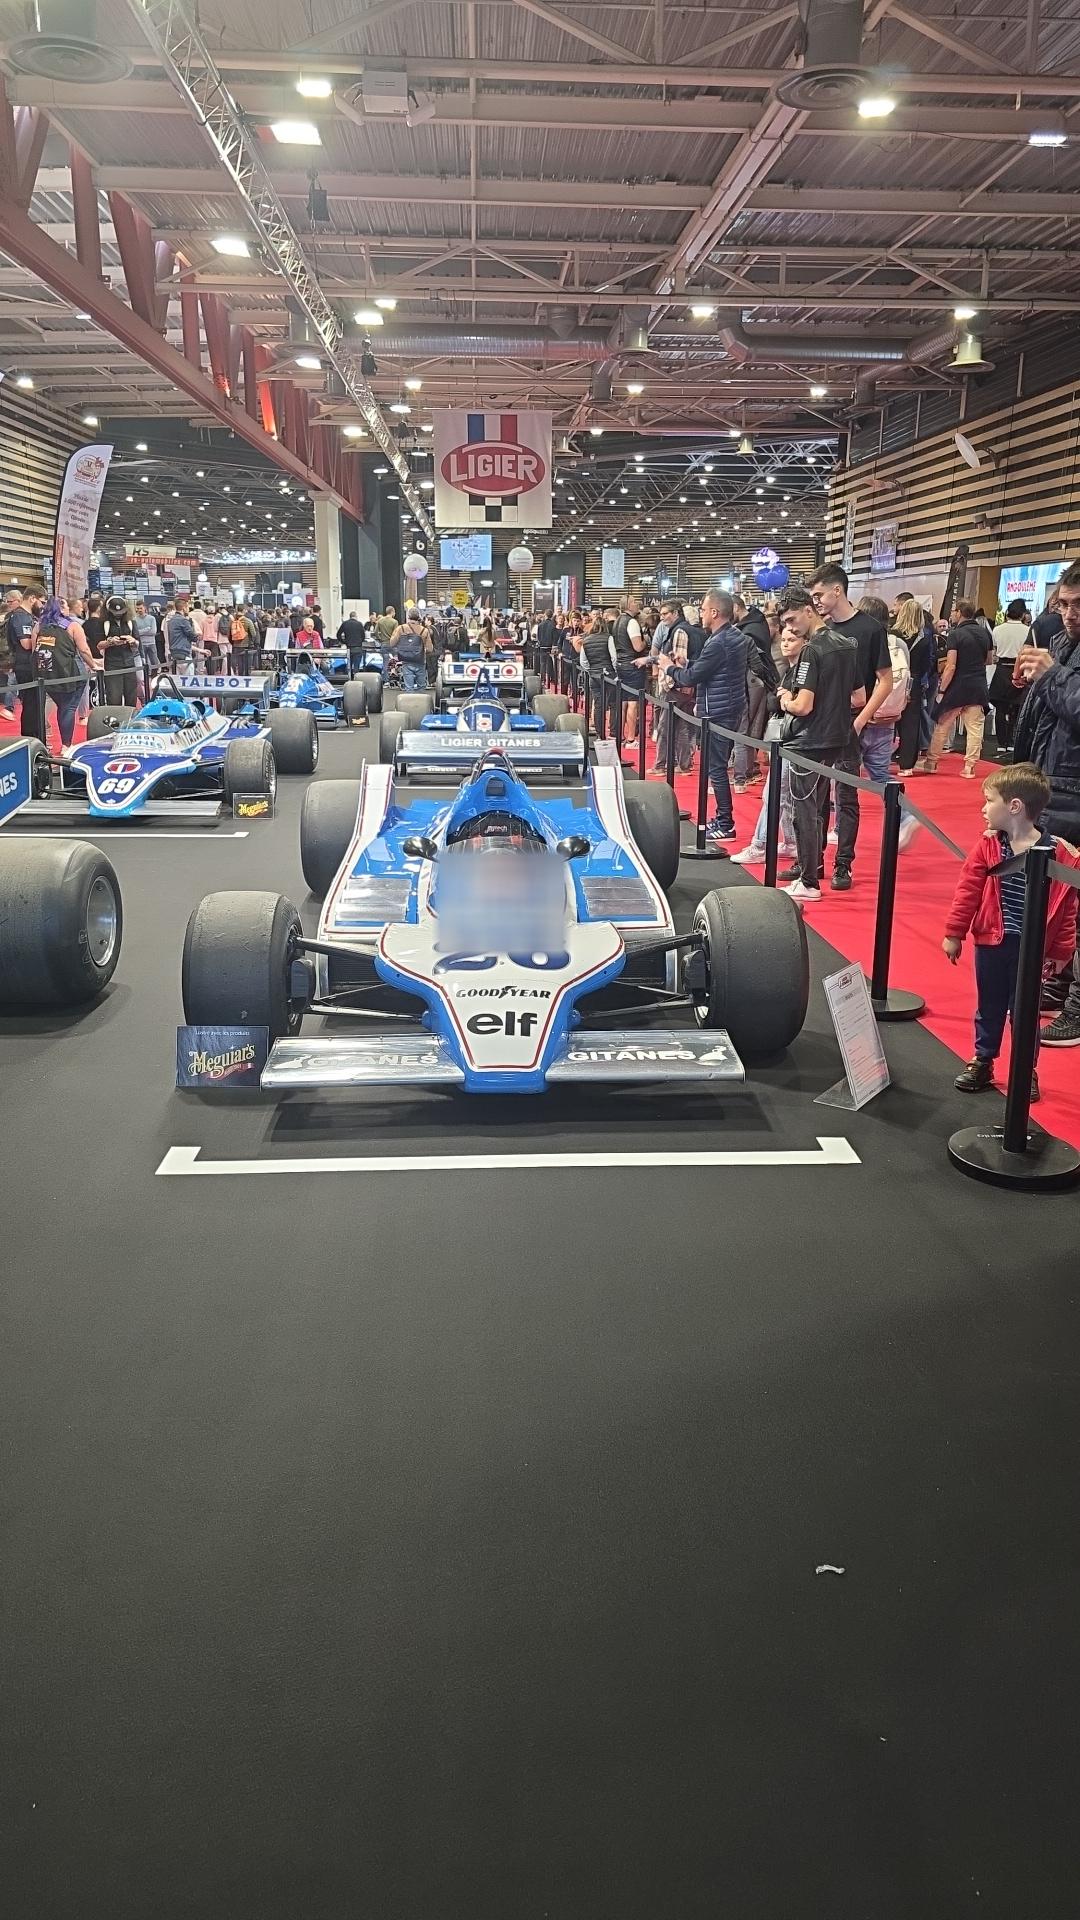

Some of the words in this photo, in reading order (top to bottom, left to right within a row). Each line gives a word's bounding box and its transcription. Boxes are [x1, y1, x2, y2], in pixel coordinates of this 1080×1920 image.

[450, 454, 538, 483] LIGIER
[416, 540, 425, 551] 6
[180, 676, 251, 688] TALBOT
[441, 739, 482, 747] LIGIER
[487, 739, 541, 747] GITANES
[97, 778, 136, 794] 69
[456, 985, 551, 999] GOODYEAR
[466, 1011, 538, 1037] elf
[188, 1043, 256, 1079] Meguiar's
[567, 1050, 697, 1061] GITANES
